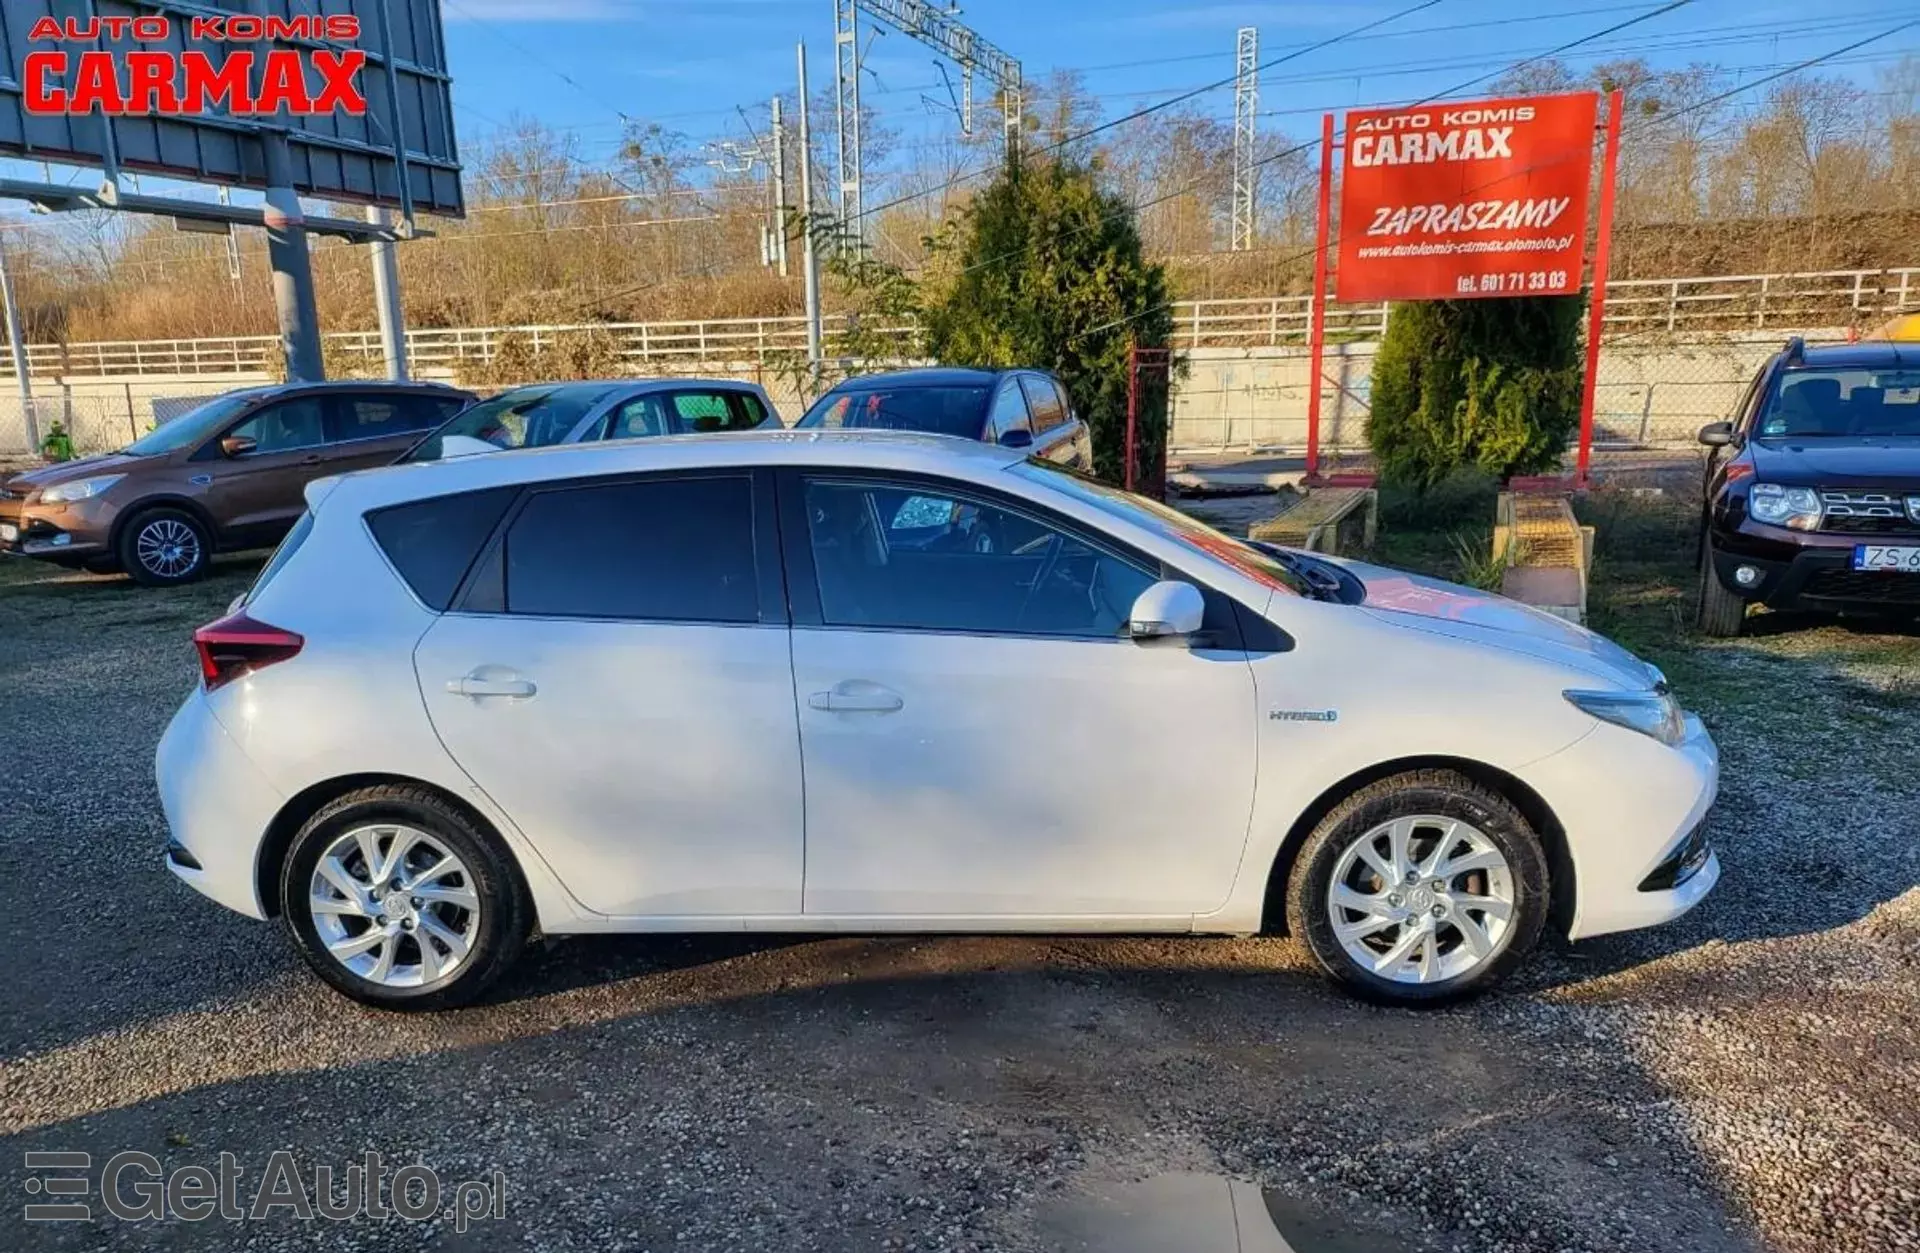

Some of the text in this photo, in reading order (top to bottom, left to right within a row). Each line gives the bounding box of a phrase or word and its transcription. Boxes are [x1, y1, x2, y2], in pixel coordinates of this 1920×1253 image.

[1355, 107, 1535, 132] AUTO KOMIS
[1352, 127, 1513, 167] CARMAX
[1367, 197, 1570, 236] ZAPRASZAMY
[1358, 234, 1574, 258] www.autokomis-carmax.otomoto.pl
[1456, 270, 1567, 293] tel. 601 71 33 03
[1869, 548, 1900, 566] ZS
